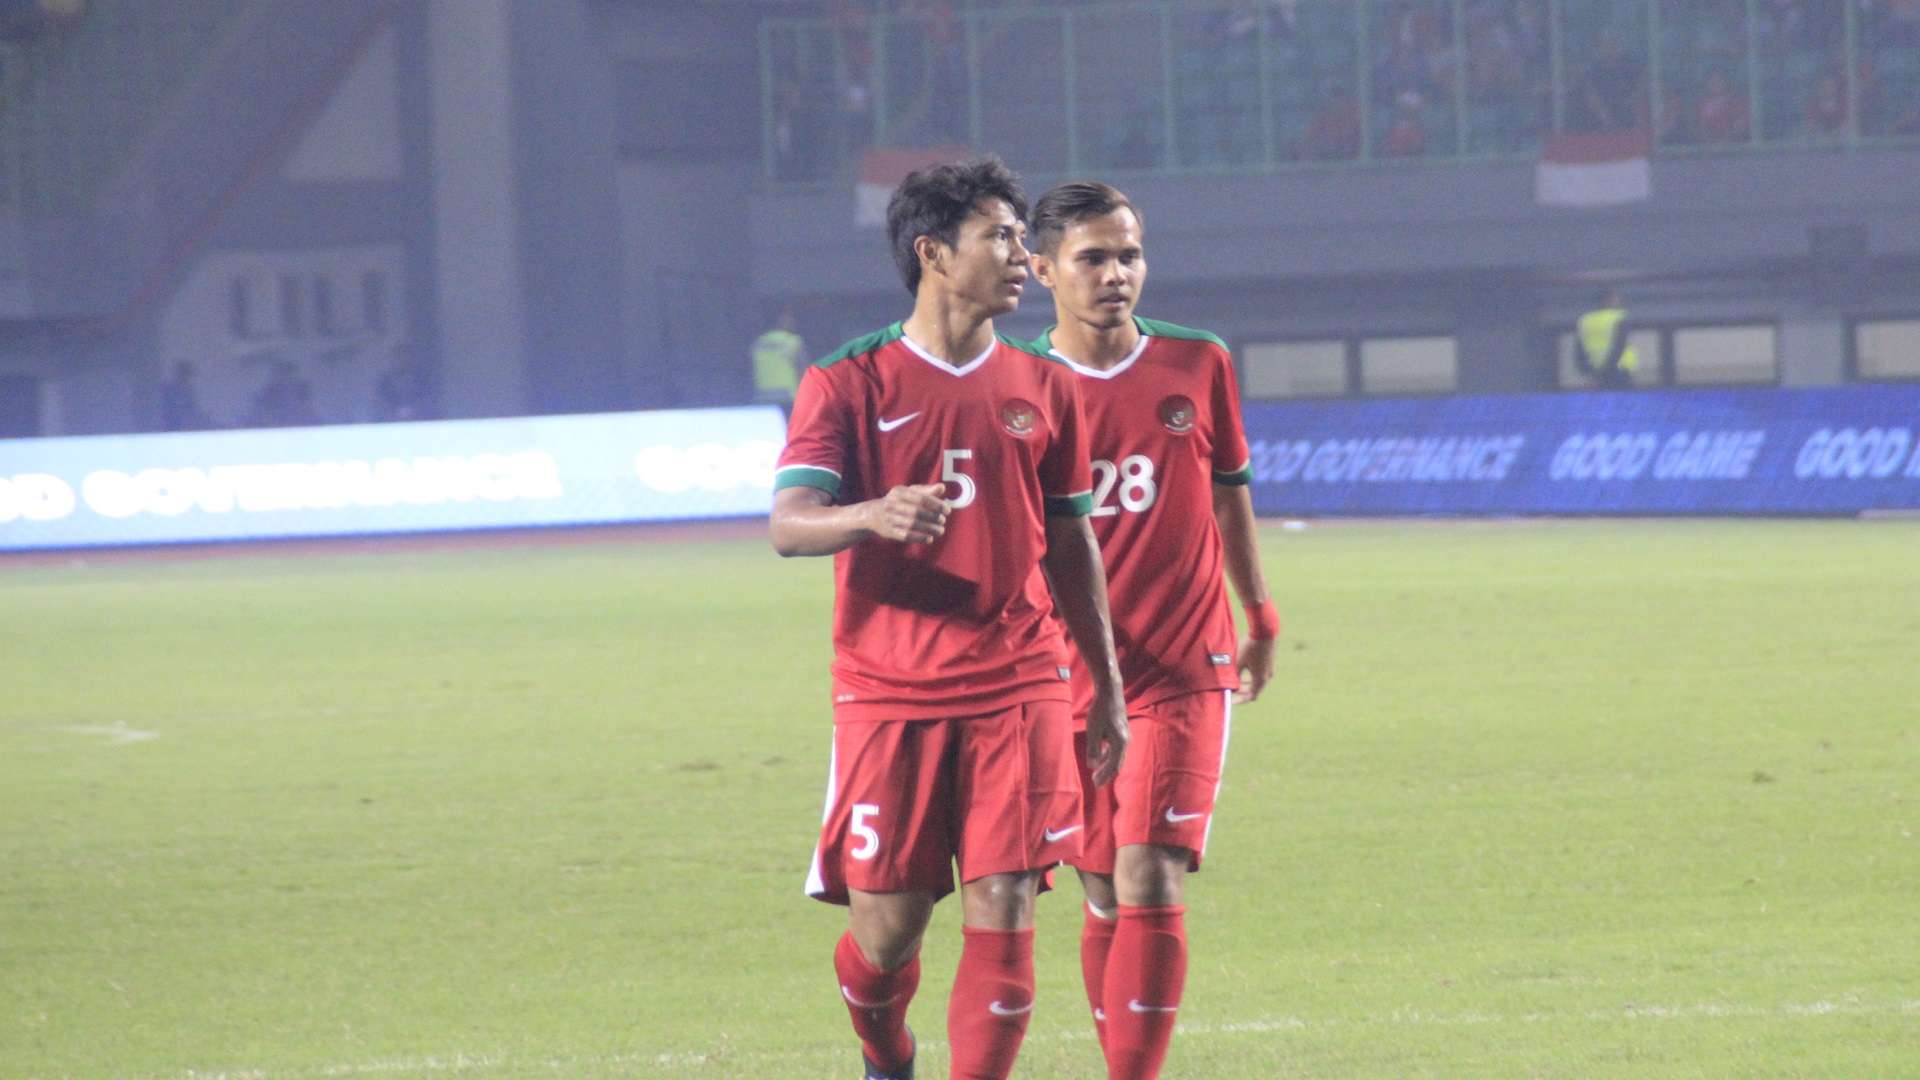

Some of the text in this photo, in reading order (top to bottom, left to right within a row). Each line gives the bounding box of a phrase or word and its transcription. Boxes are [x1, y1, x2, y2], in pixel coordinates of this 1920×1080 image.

[942, 448, 976, 509] 5
[1301, 433, 1526, 482] GOVERNANCE
[1550, 428, 1766, 481] GOOD GAME
[1794, 427, 1911, 480] GOOD
[1091, 454, 1157, 516] 28
[851, 804, 880, 860] 5
